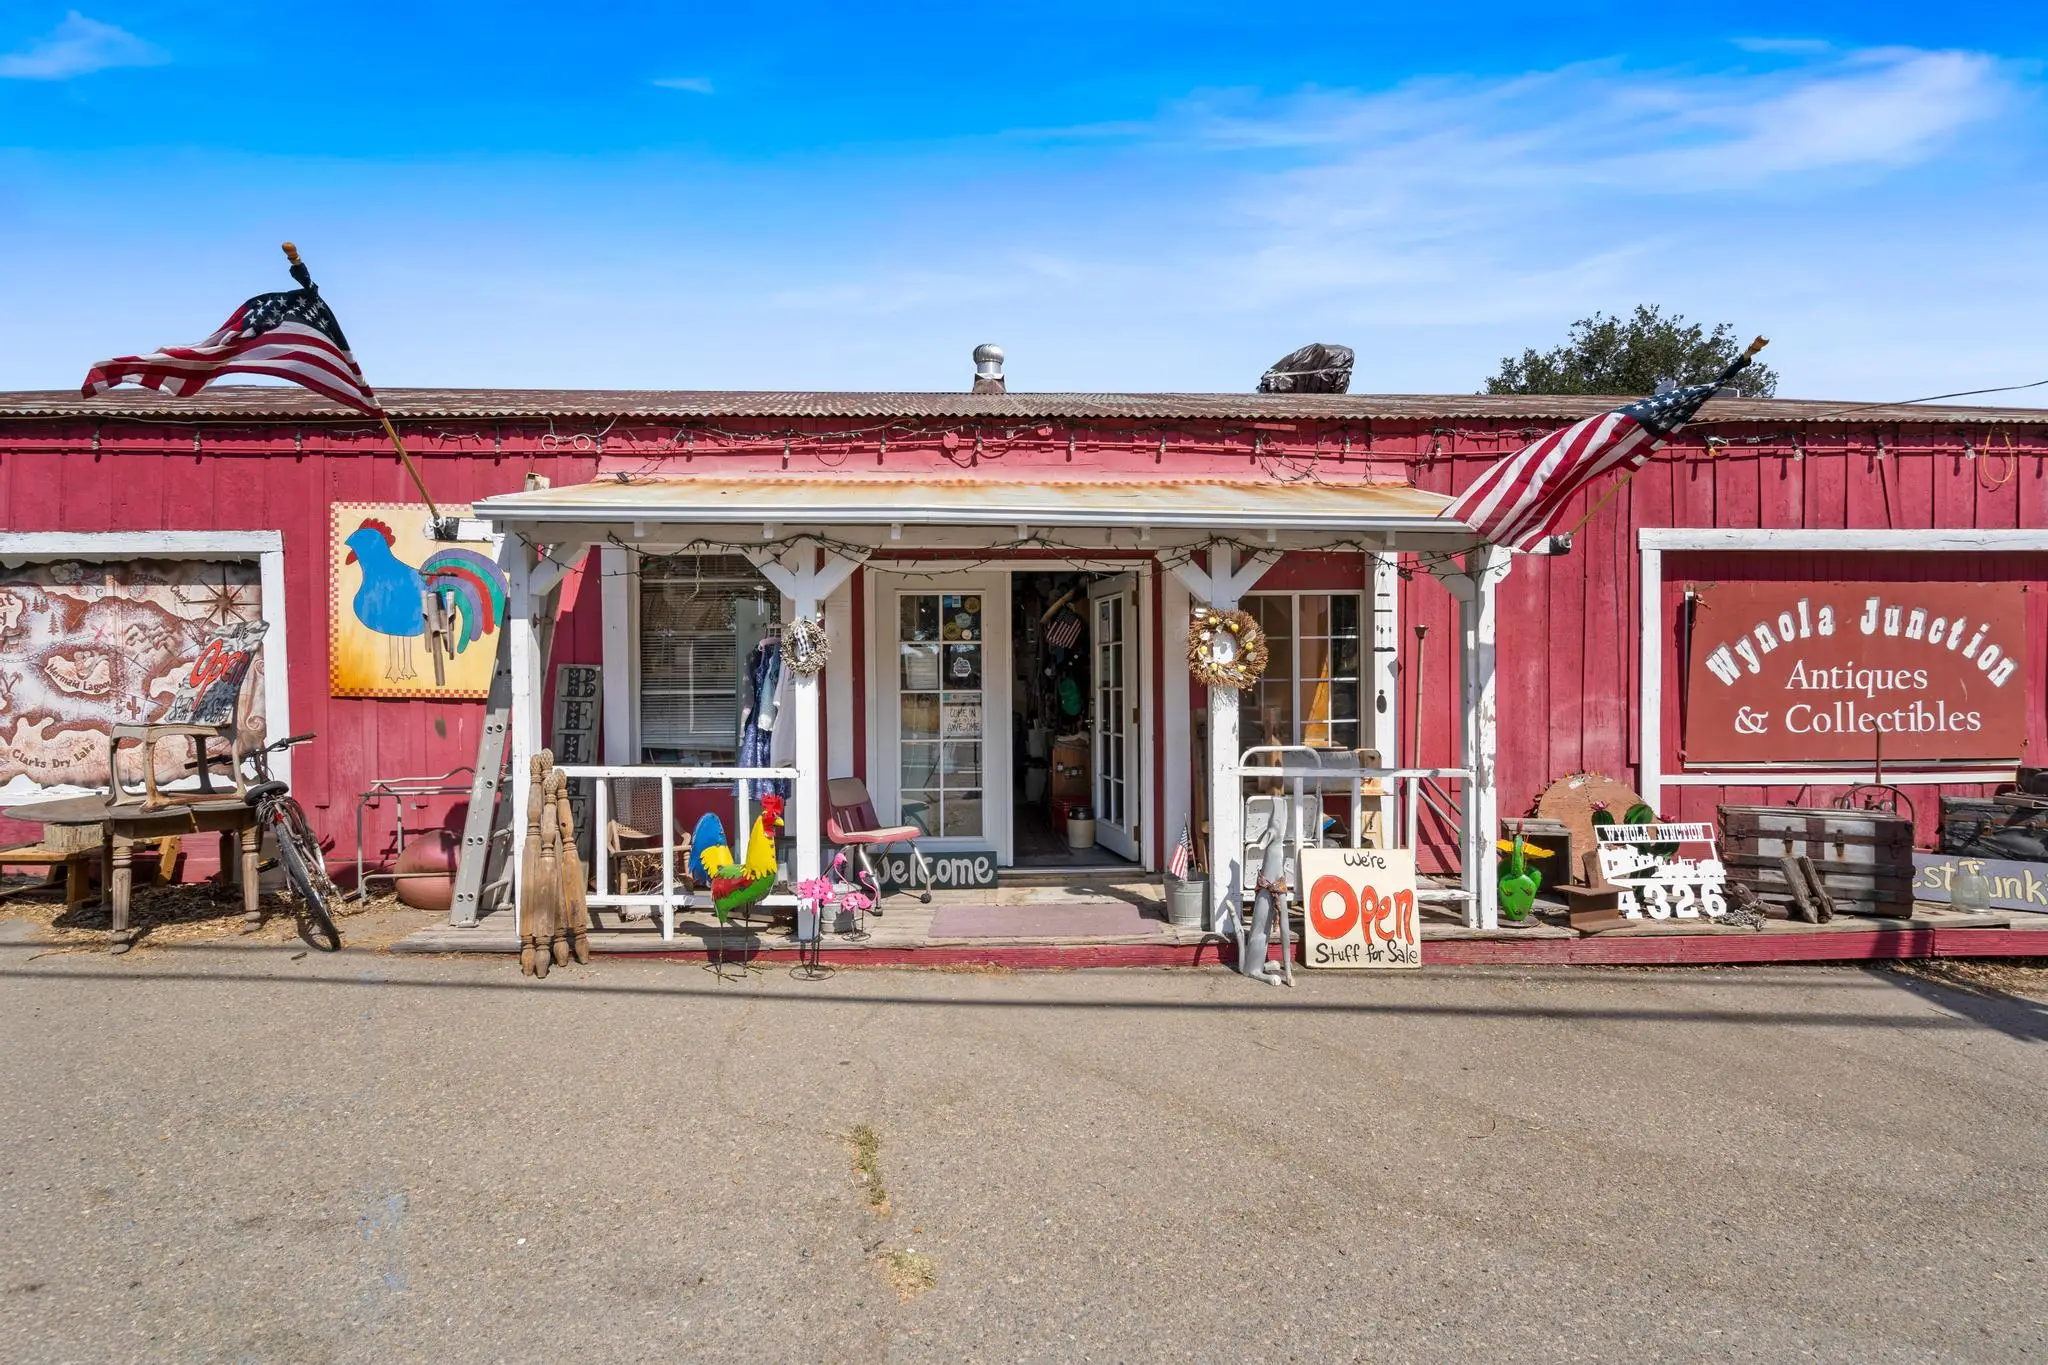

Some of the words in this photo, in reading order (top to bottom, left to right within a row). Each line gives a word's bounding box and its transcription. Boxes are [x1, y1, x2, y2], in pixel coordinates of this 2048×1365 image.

[1705, 597, 1837, 687] Wynola
[1860, 596, 2018, 688] Junction
[46, 663, 80, 689] Mermaid
[189, 639, 250, 712] Open
[1785, 659, 1929, 699] Antiques
[1734, 705, 1769, 734] &
[1785, 700, 1982, 734] Collectibles
[12, 749, 46, 768] Clarks
[52, 759, 71, 768] Dry
[73, 743, 96, 761] Lake
[1604, 826, 1650, 841] WYNOLA
[1656, 825, 1703, 840] JUNCTION
[1344, 851, 1387, 869] We're
[1309, 874, 1415, 945] Open
[1618, 883, 1727, 919] 4326
[1315, 942, 1360, 963] Stuff
[1365, 943, 1385, 963] for
[1387, 939, 1418, 964] Sale
